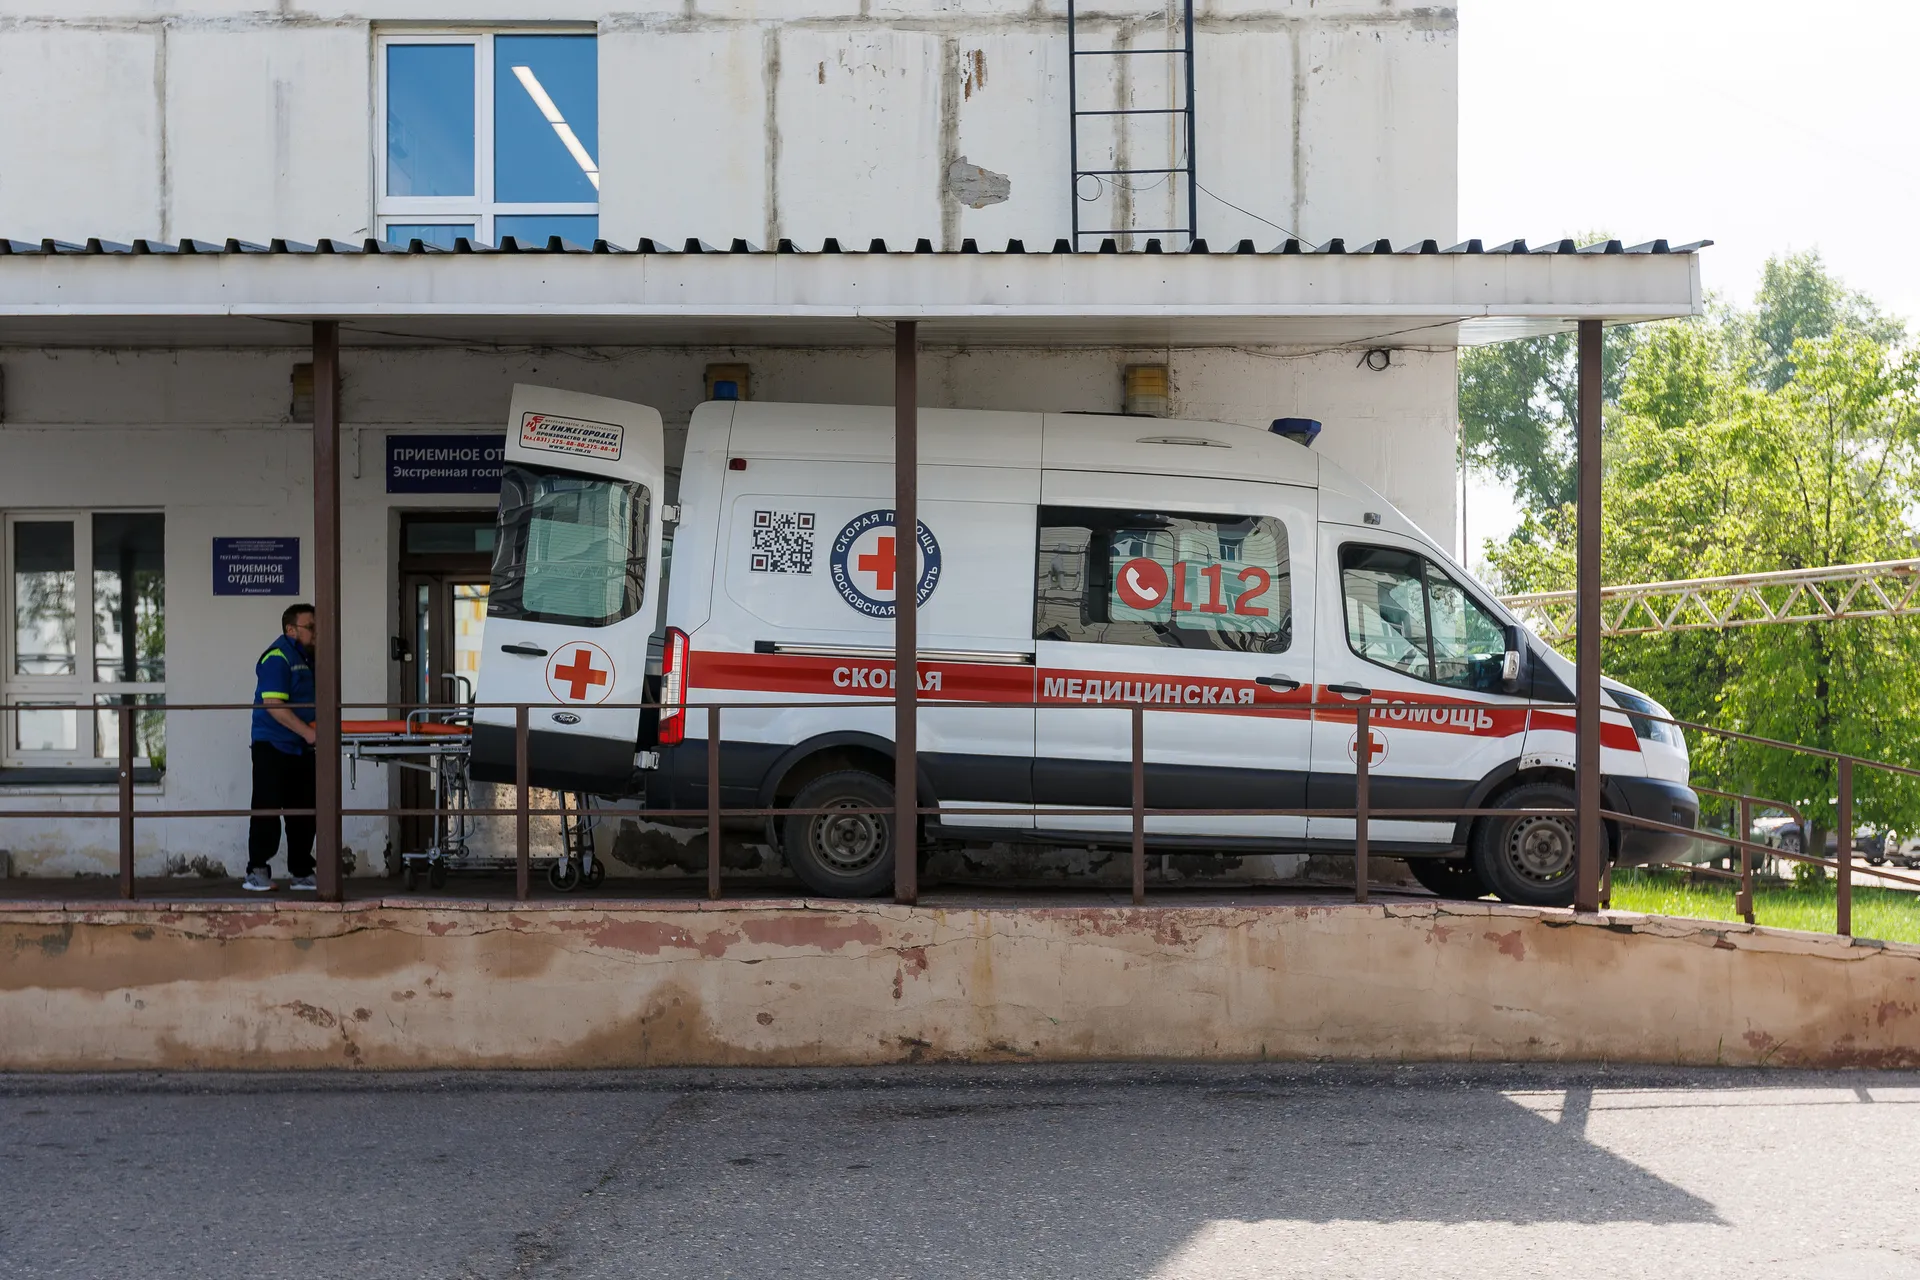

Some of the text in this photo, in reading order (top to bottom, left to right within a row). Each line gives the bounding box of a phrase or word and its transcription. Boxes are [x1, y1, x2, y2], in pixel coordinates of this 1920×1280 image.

[550, 425, 618, 440] НИЖЕГОРОДЕЦ
[393, 448, 480, 461] ПРИЕМНОЕ
[393, 466, 468, 480] Экстренная
[836, 512, 936, 555] СКОРАЯ ПОЩЬ
[228, 564, 283, 573] ПРИЕМНОЕ
[227, 574, 285, 585] ОТДЕЛЕНИЕ
[833, 563, 938, 616] МОСКОВСКАЯ ЛАСТЬ
[1171, 560, 1271, 617] 112
[832, 666, 1494, 732] СКОЯ МЕДИЦИНСКАЯ ПОМОЩЬ
